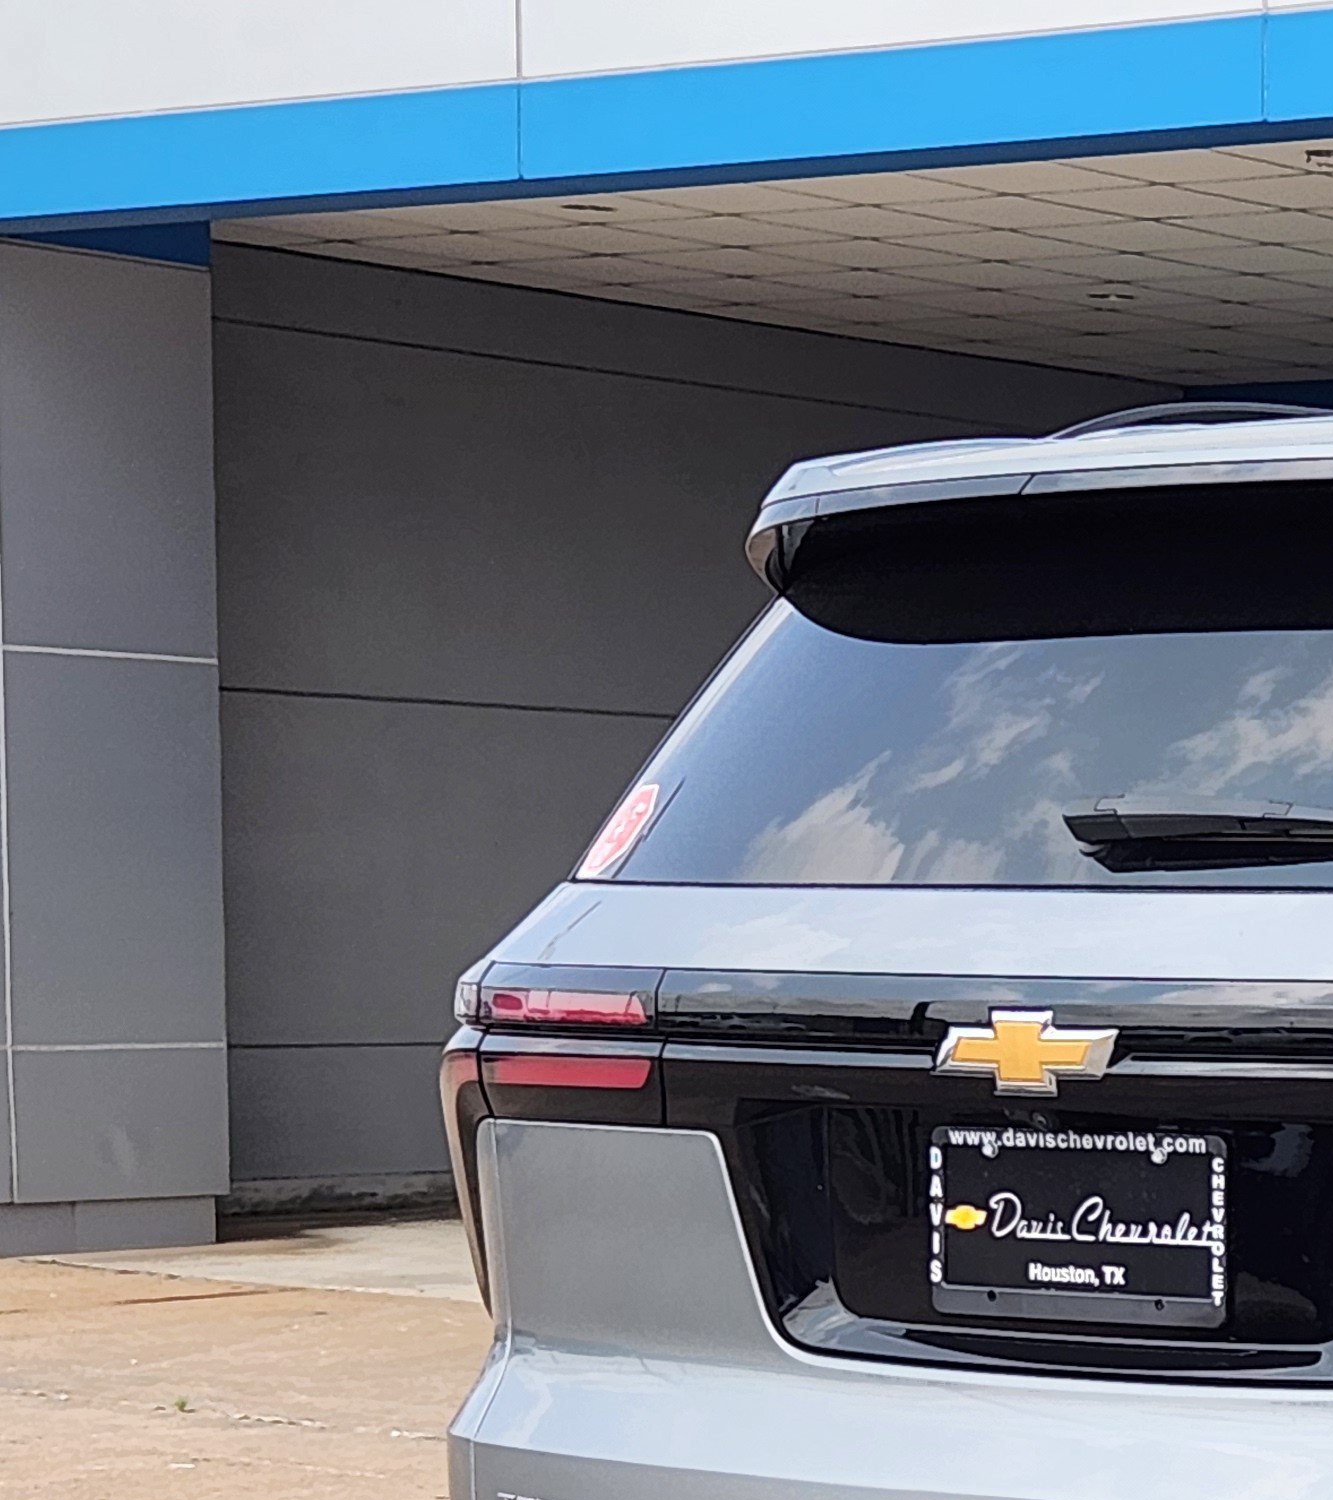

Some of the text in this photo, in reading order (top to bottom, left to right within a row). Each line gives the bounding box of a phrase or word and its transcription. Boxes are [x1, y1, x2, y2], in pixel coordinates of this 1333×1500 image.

[947, 1127, 1207, 1154] www.davischevroletcom
[929, 1146, 943, 1283] DAVIS
[989, 1192, 1214, 1248] Davis Chevrolet
[1211, 1157, 1225, 1307] CHEVROLET
[1028, 1262, 1126, 1287] Houston, TX
